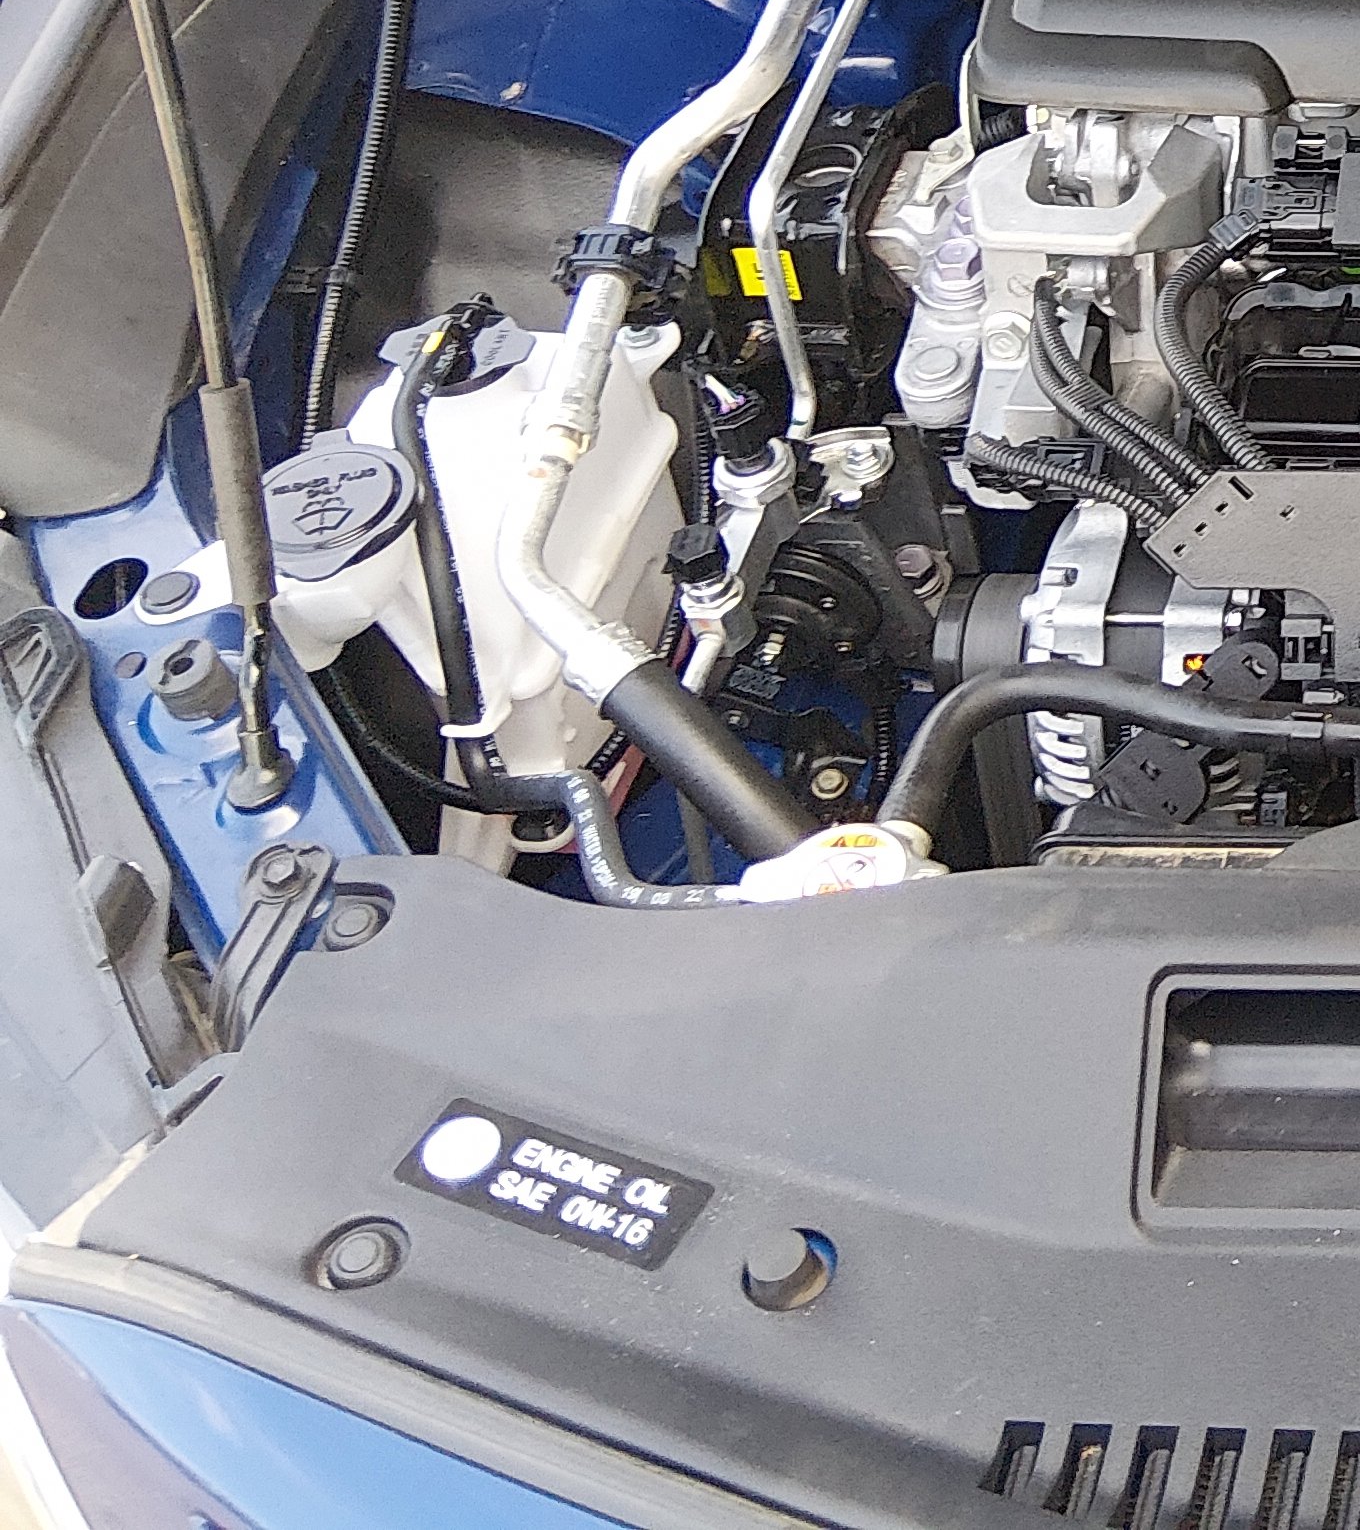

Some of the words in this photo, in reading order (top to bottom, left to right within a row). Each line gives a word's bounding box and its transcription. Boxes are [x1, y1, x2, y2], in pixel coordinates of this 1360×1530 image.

[488, 1170, 558, 1212] SAE
[559, 1195, 655, 1246] 0W-16
[512, 1137, 622, 1194] ENGINE
[622, 1176, 672, 1215] OIL
